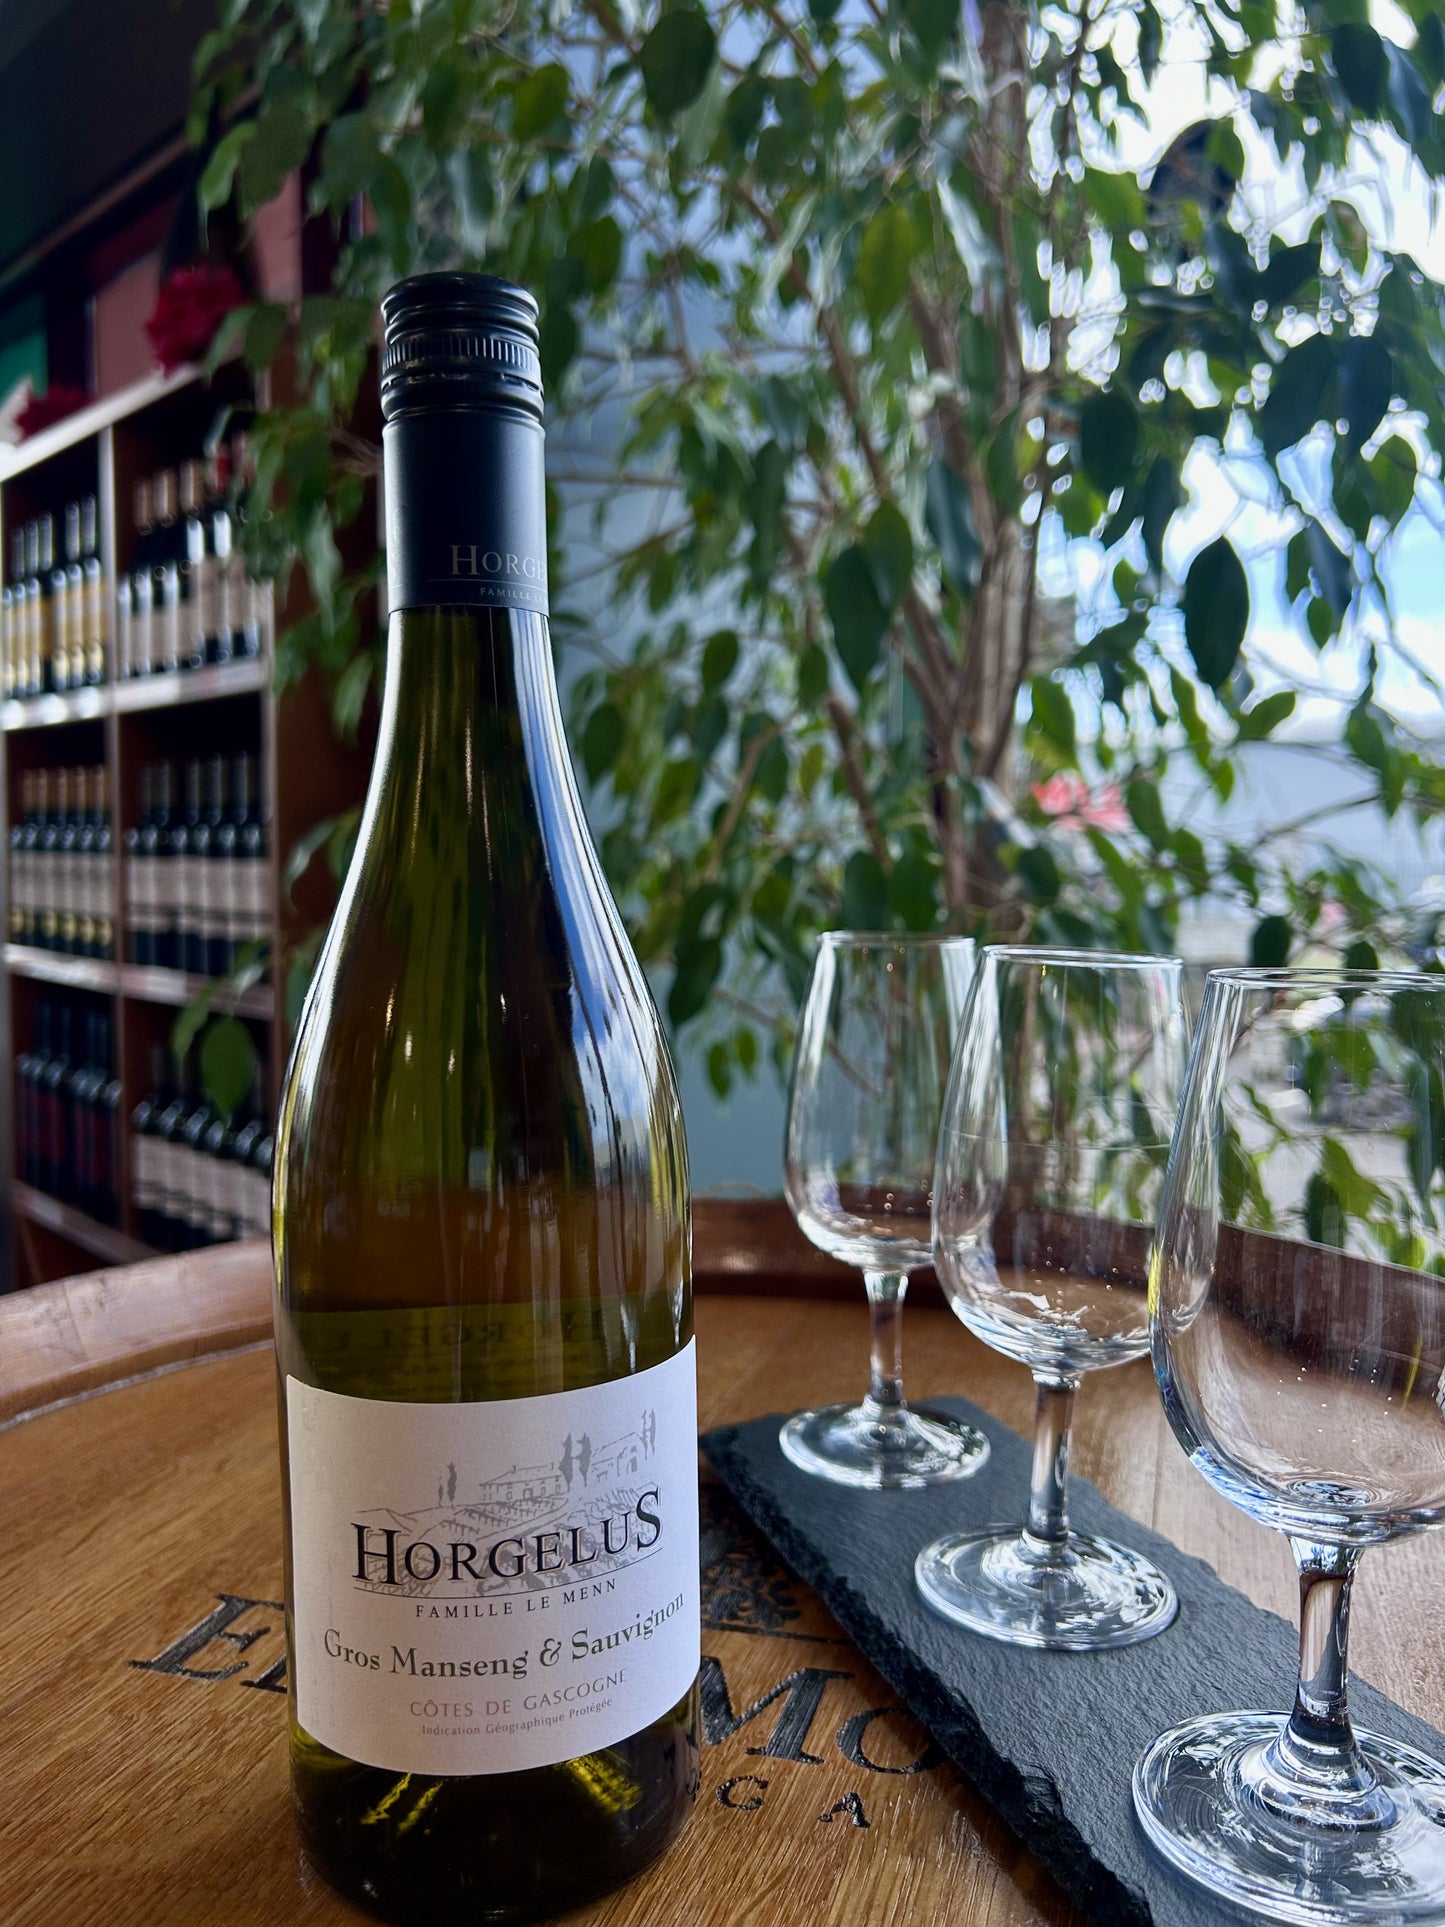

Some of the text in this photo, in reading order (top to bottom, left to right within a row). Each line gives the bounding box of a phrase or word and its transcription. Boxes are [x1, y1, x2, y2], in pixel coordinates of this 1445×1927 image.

[351, 1487, 662, 1586] HORGELUS
[415, 1578, 617, 1618] FAMILLE LE MENN
[324, 1593, 685, 1680] Gros Manseng & Sauvignon
[410, 1667, 627, 1718] CÔTES DE GASCOGNE
[422, 1698, 613, 1736] Indication Géographique Protégée
